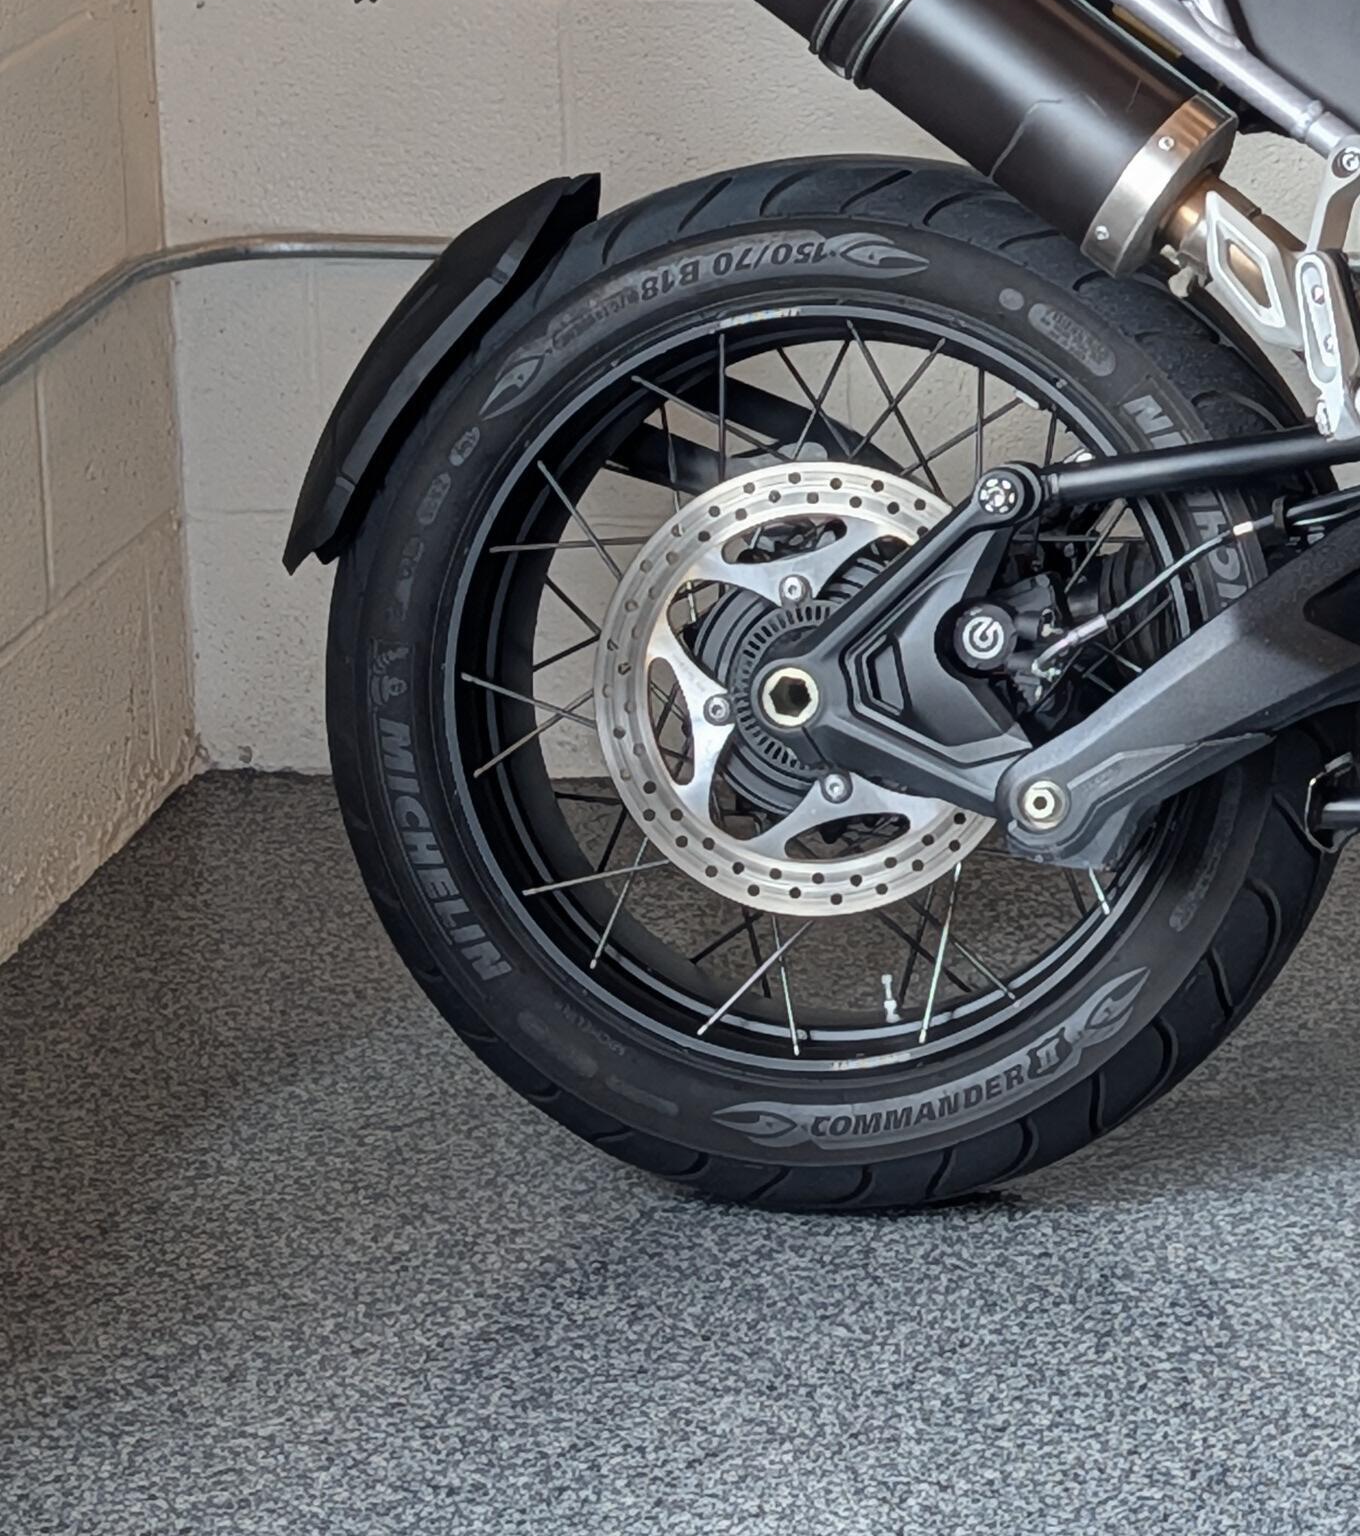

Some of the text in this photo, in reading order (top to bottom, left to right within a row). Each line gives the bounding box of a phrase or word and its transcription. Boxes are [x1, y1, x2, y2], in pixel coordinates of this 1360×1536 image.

[639, 263, 701, 300] B18
[713, 240, 828, 276] 150/70
[379, 717, 513, 982] MICHELIN
[809, 1063, 1026, 1137] COMMANDER
